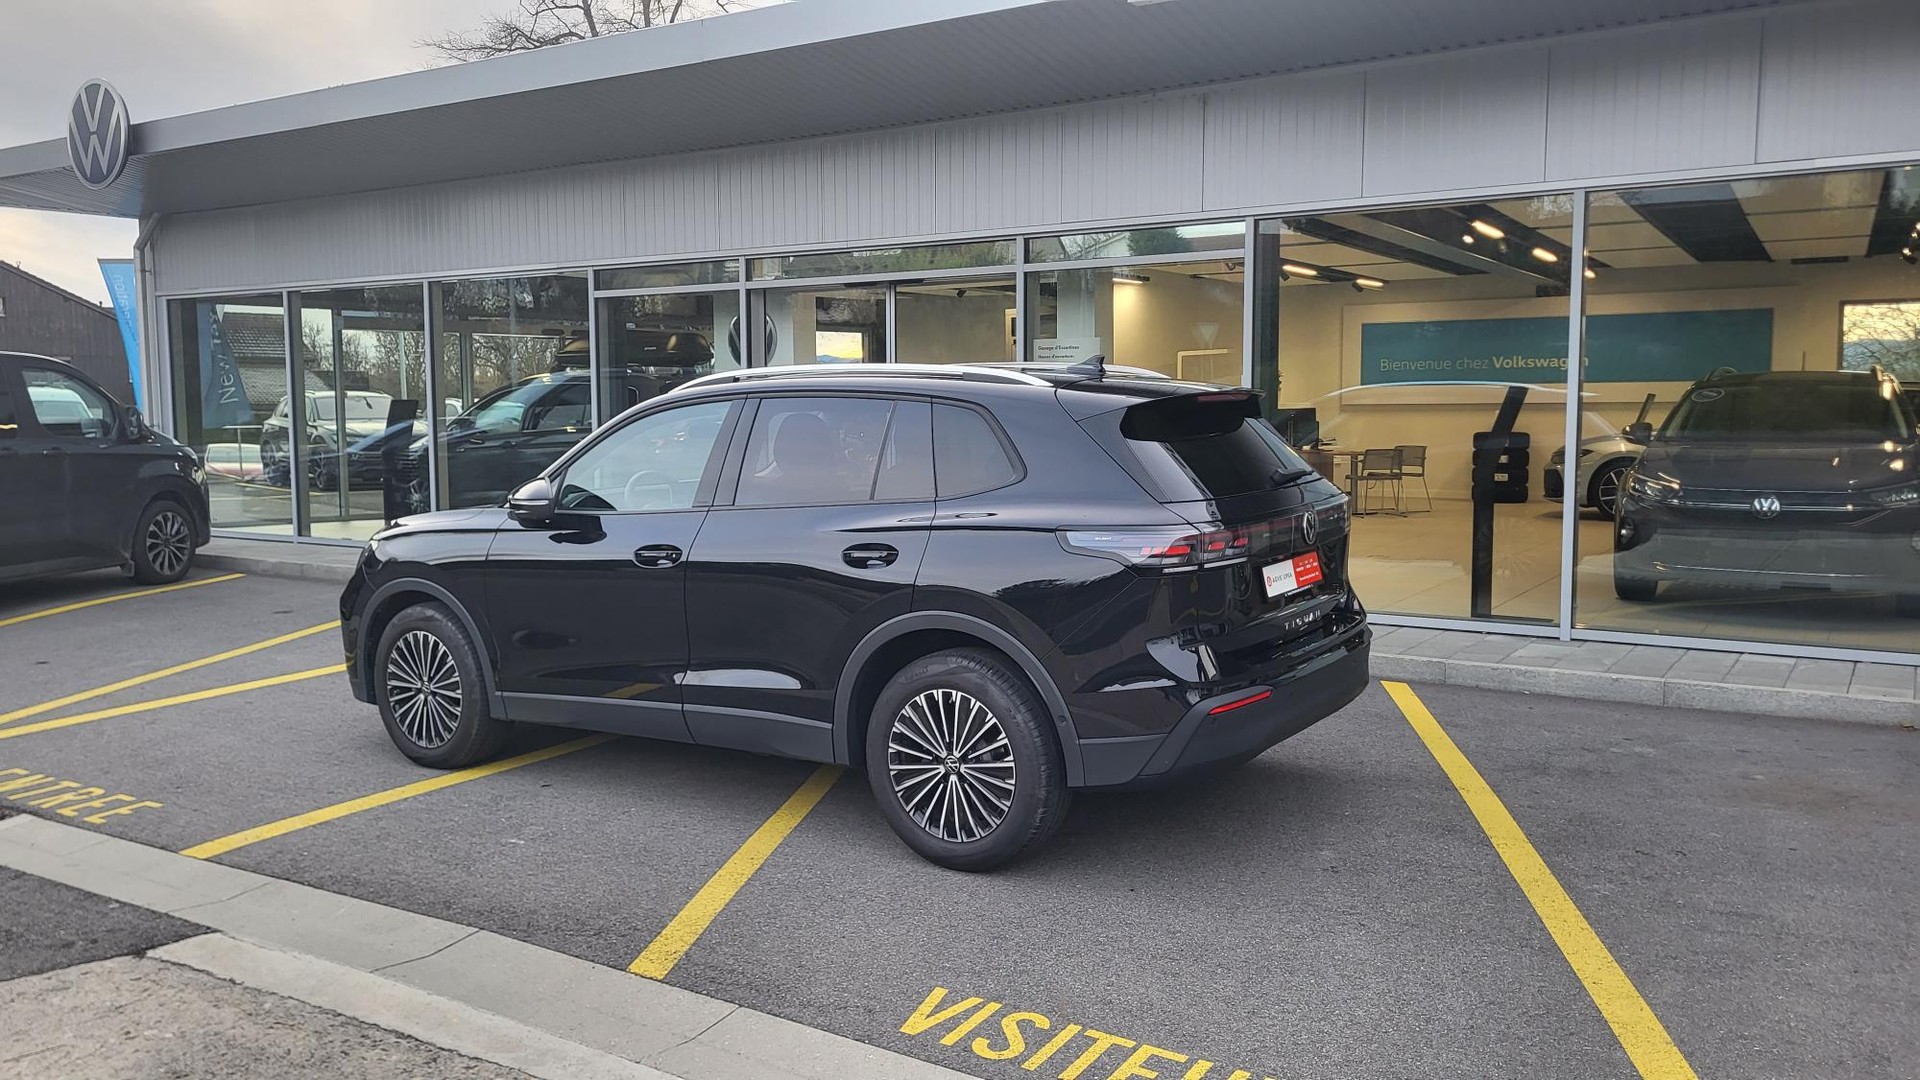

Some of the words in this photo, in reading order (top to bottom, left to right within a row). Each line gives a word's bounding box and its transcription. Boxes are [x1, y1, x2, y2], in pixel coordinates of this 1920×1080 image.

[216, 354, 239, 404] New
[1380, 358, 1452, 371] Bienvenue
[1456, 357, 1489, 369] chez
[1492, 355, 1589, 371] Volkswagn
[899, 986, 1276, 1080] VISITE
